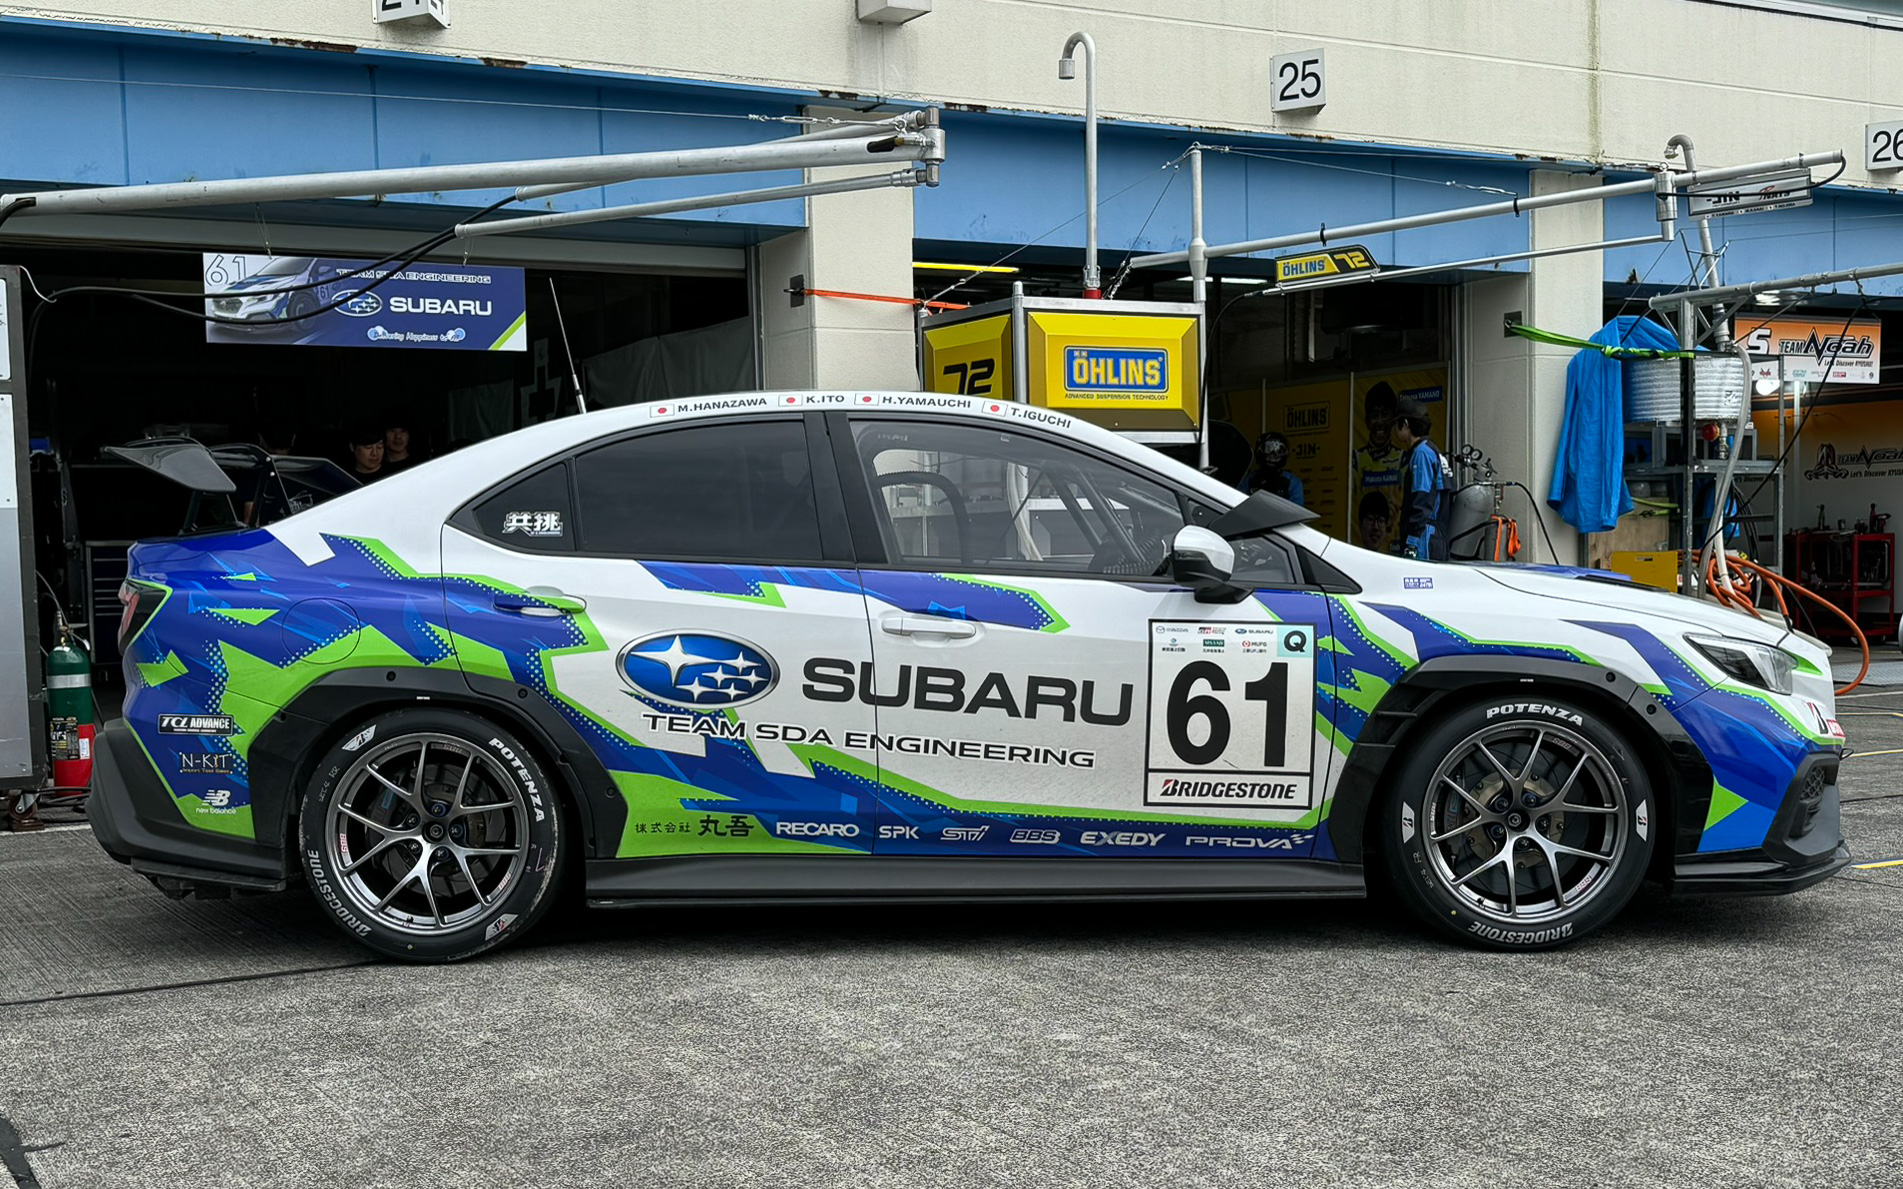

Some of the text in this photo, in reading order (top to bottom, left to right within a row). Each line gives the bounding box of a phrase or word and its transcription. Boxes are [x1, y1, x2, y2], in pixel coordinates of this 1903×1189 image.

[1278, 58, 1322, 101] 25
[205, 254, 247, 287] 61
[1283, 251, 1370, 277] ÖHLINS 72
[376, 270, 407, 280] SA
[406, 272, 492, 284] ENGINEERING
[389, 296, 492, 316] SUBARU
[1779, 340, 1805, 354] TEAM
[942, 358, 995, 395] 72
[1073, 351, 1161, 386] ÖHLINS
[677, 397, 767, 413] M.HANAZAWA
[806, 395, 845, 404] K.ITO
[882, 396, 971, 409] H.YAMAUCHI
[1011, 407, 1072, 429] T.IGUCHI
[1283, 630, 1307, 653] Q
[801, 655, 1134, 727] SUBARU
[190, 718, 230, 729] ADVANCE
[1166, 659, 1289, 767] 61
[1486, 702, 1584, 727] POTENZA
[642, 713, 1096, 769] TEAM SDA ENGINEERING
[488, 737, 546, 823] POTENZA
[1159, 778, 1298, 800] BRIDGESTONE
[635, 822, 692, 834] 株式会社
[775, 821, 860, 838] RECARO
[878, 825, 920, 840] SPK
[1010, 828, 1061, 844] BBS
[1079, 831, 1166, 847] EXEDY
[1185, 835, 1294, 850] PROVA
[307, 849, 373, 938] BRIDGESTONE
[1467, 920, 1574, 944] BRIDGESTONE
